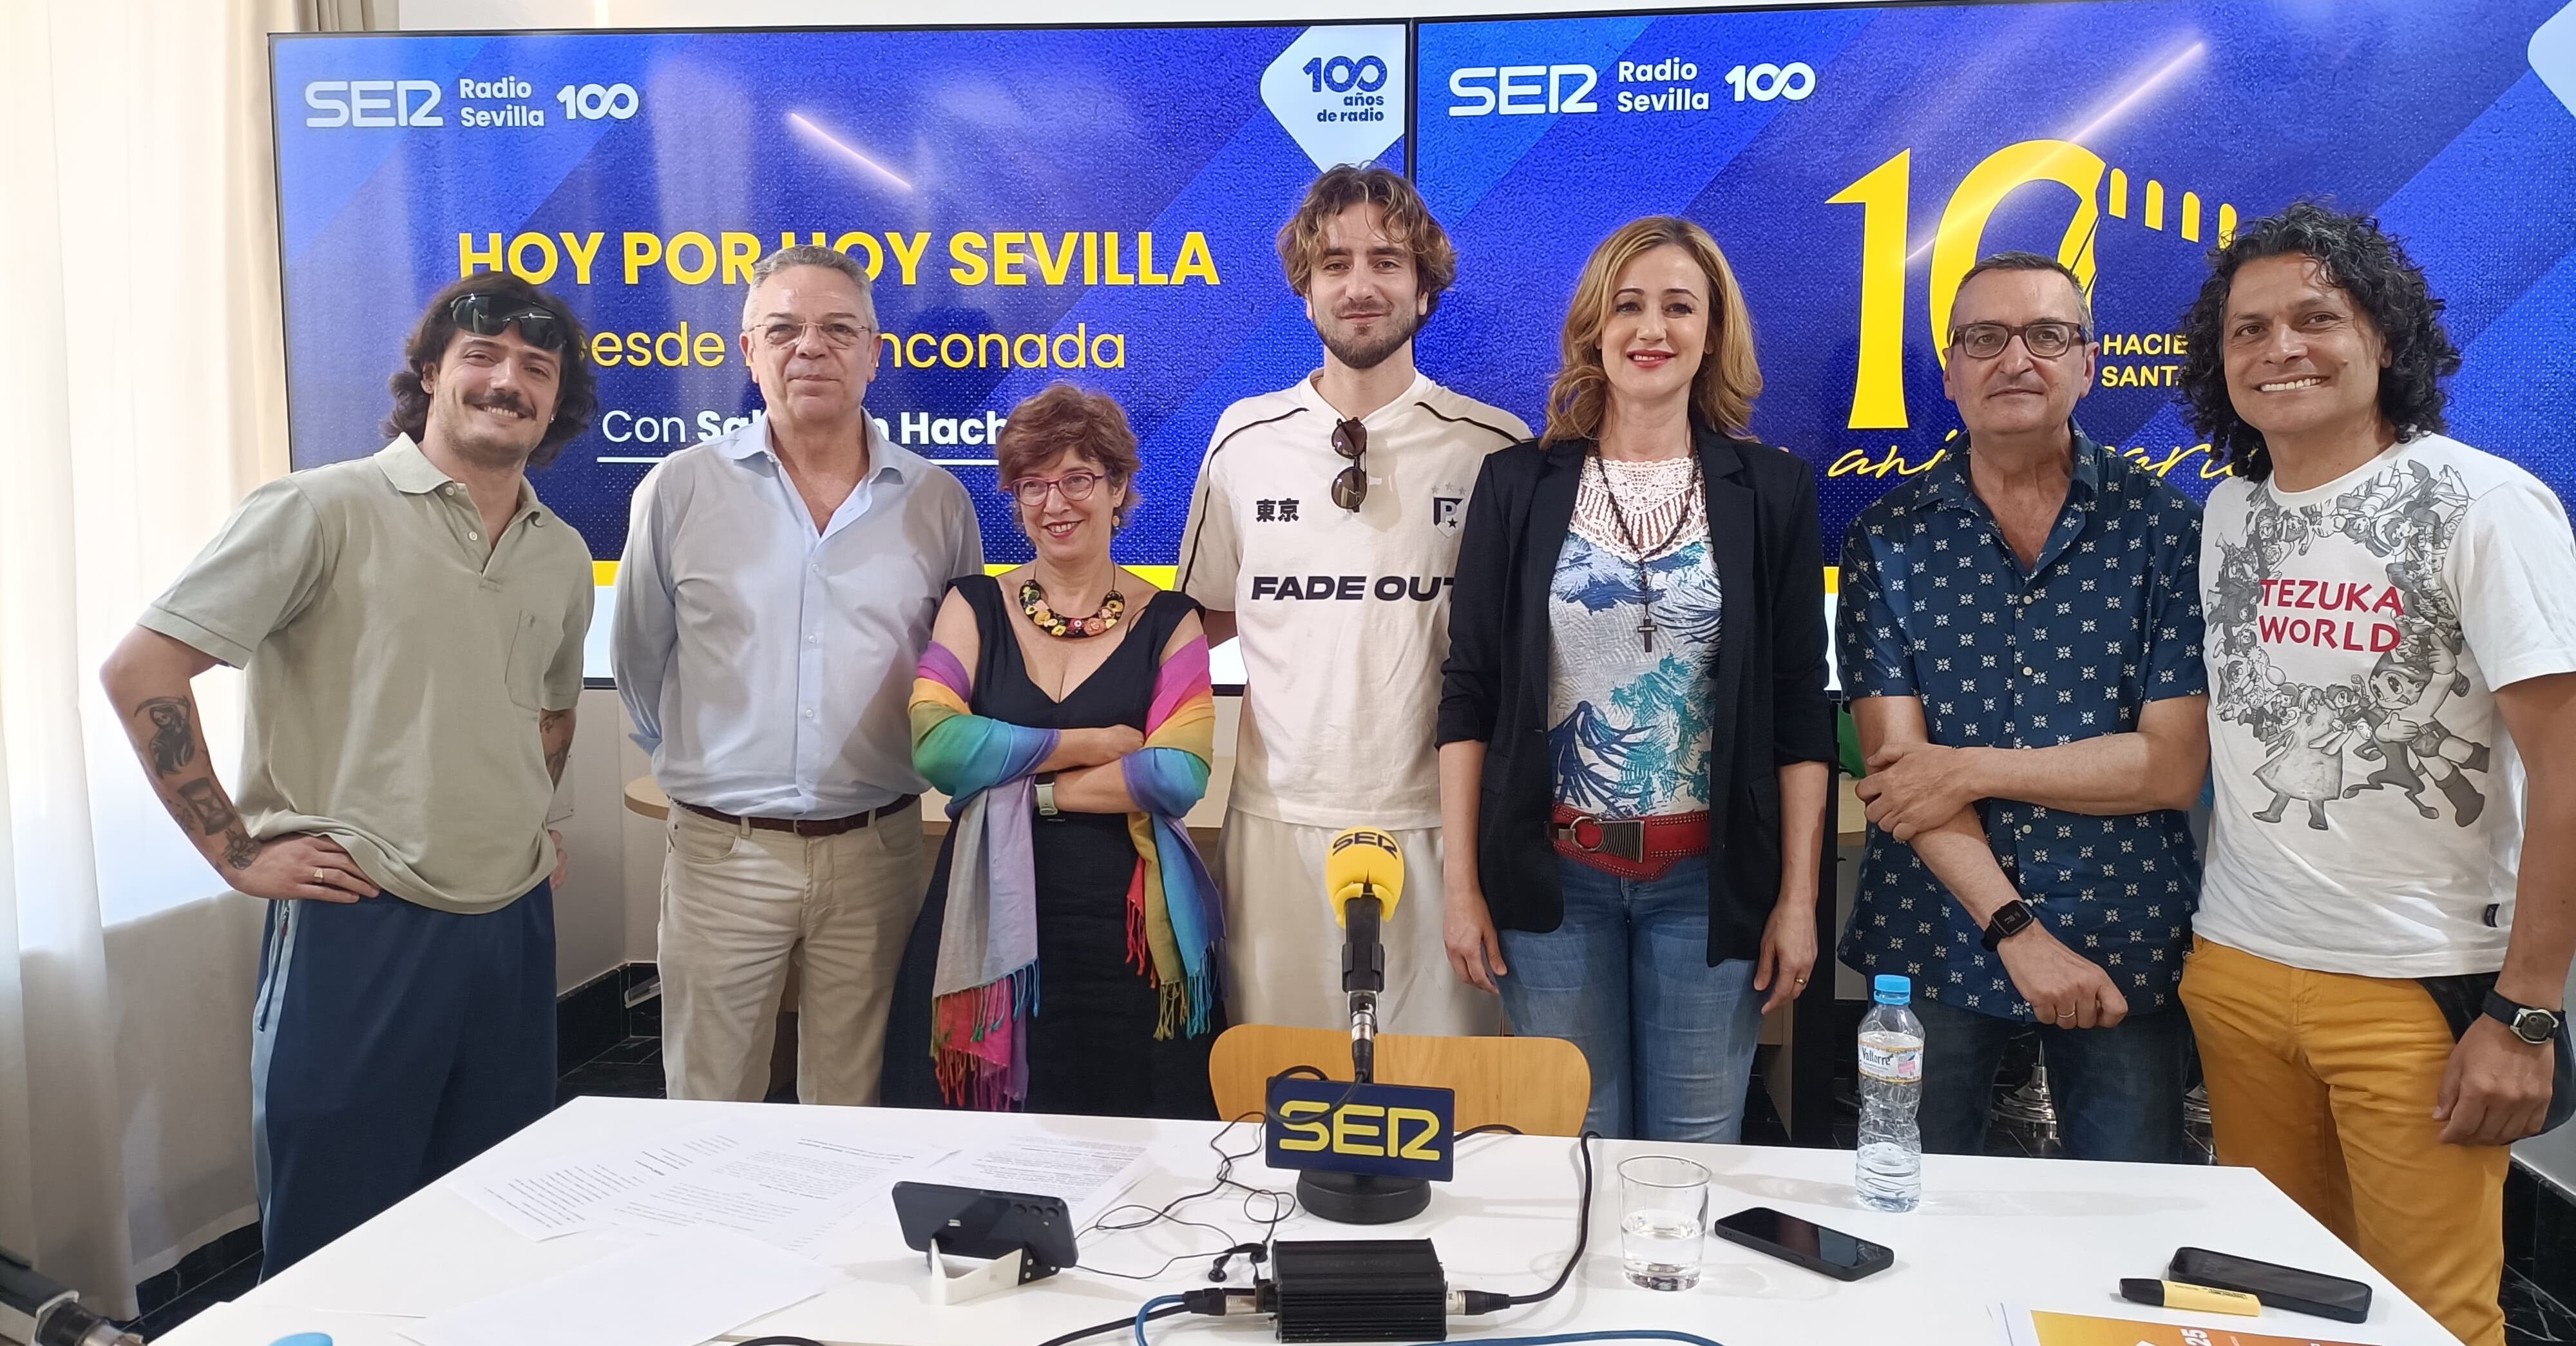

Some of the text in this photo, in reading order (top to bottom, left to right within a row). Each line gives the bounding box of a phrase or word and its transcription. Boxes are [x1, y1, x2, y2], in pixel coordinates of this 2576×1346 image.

[1302, 55, 1388, 92] 100
[1618, 57, 1698, 82] Radio
[1724, 62, 1817, 102] 100
[459, 76, 532, 99] Radio
[556, 82, 639, 120] 100
[1343, 92, 1384, 106] años
[1449, 63, 1598, 117] SER
[1617, 87, 1710, 113] Sevilla
[305, 80, 444, 128] SER
[460, 104, 545, 127] Sevilla
[1317, 107, 1384, 122] de radio
[459, 231, 1220, 286] HOY POR OY SEVILLA
[581, 321, 726, 367] esde
[875, 323, 1126, 369] nconada
[2103, 334, 2189, 355] HACIE
[2101, 365, 2180, 387] SANT
[602, 410, 687, 443] Con
[901, 410, 1008, 445] Hach
[1255, 498, 1300, 523] 東京
[1251, 576, 1367, 601] FADE
[2260, 579, 2403, 616] TEZUKA
[2258, 615, 2401, 653] WORLD
[1332, 831, 1397, 860] SER
[1279, 1099, 1441, 1161] SER
